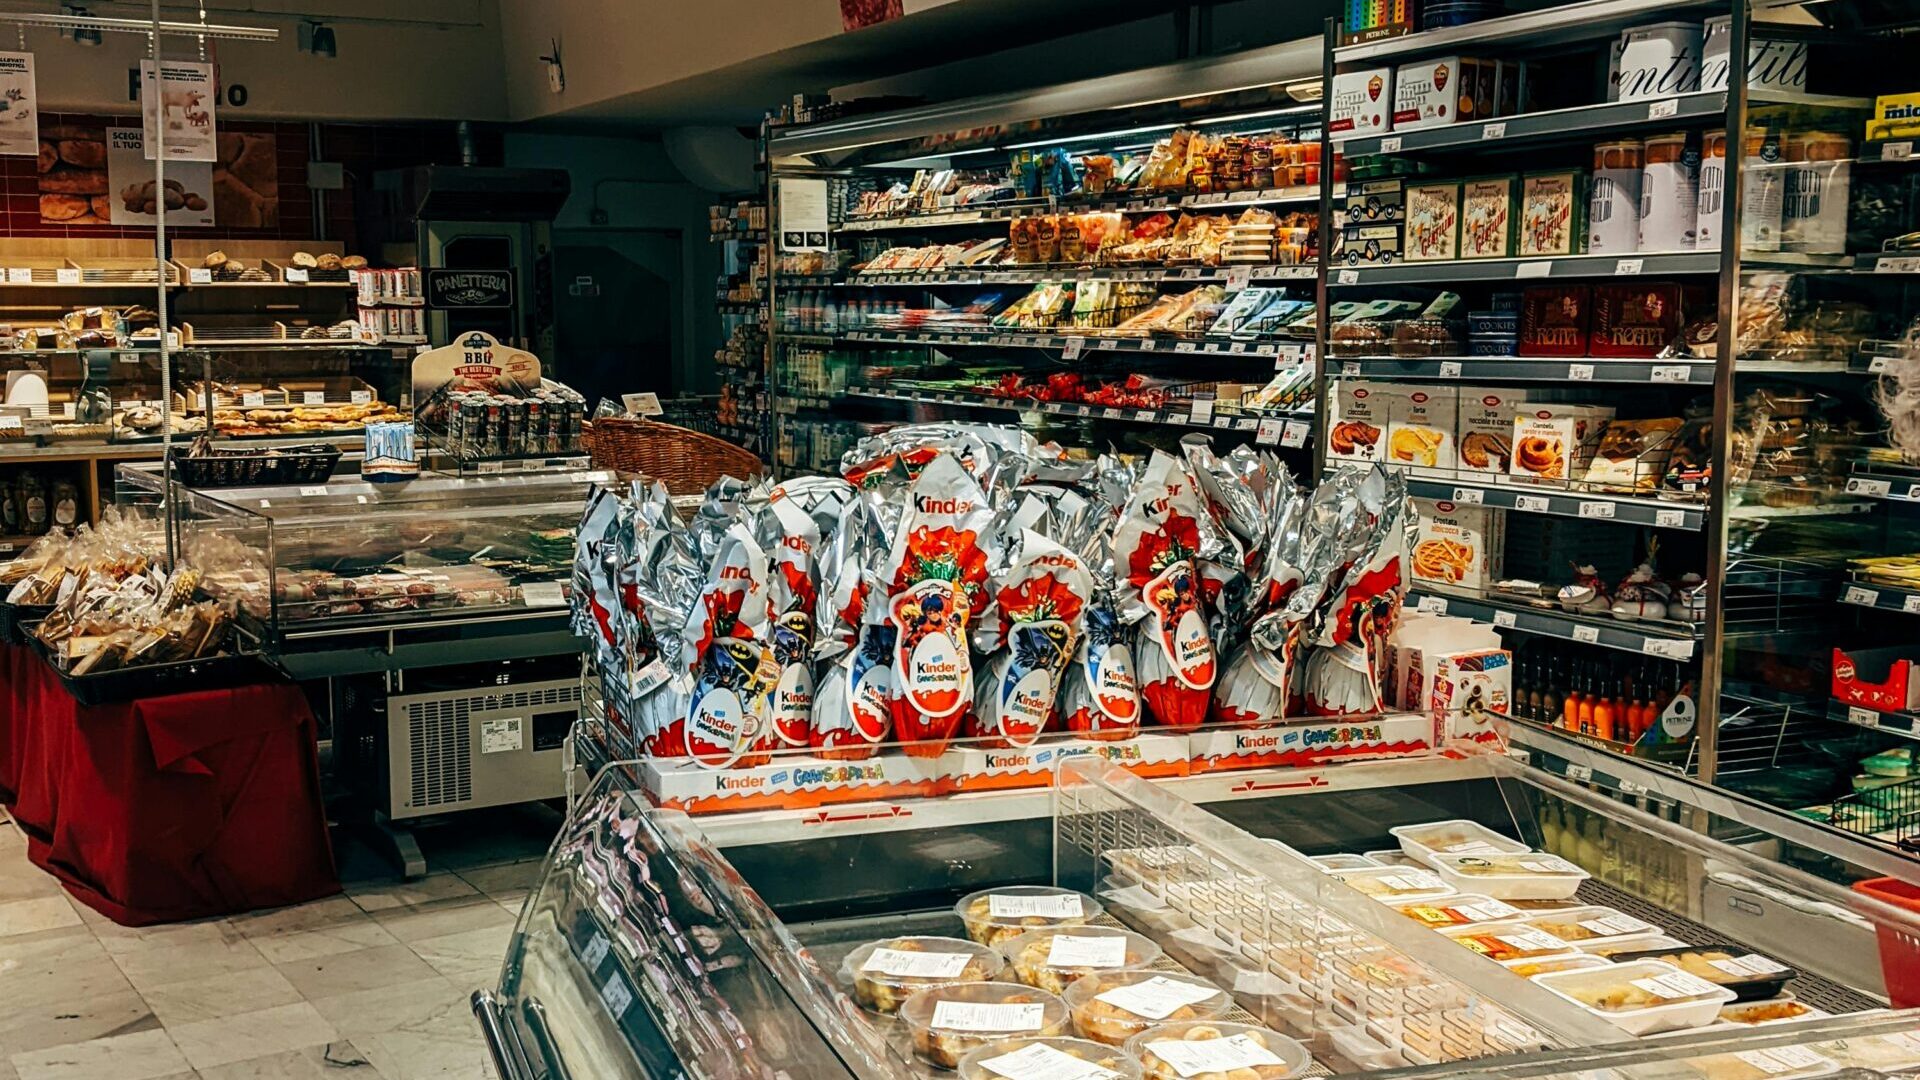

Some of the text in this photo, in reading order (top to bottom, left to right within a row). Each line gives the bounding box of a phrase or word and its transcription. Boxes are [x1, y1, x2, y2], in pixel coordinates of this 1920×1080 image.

[123, 141, 142, 149] TUO
[435, 274, 507, 292] PANETTERIA
[1479, 320, 1516, 330] COOKIES
[1536, 328, 1579, 345] ROMA
[1612, 327, 1665, 346] ROMA
[1476, 344, 1511, 354] COOKIES
[464, 351, 494, 364] BBQ
[914, 491, 973, 514] Kinder
[917, 661, 956, 674] Kinder
[1016, 691, 1046, 709] Kinder
[700, 707, 738, 732] Kinder
[1236, 734, 1279, 748] Kinder
[986, 754, 1031, 768] Kinder
[716, 776, 766, 790] Kinder
